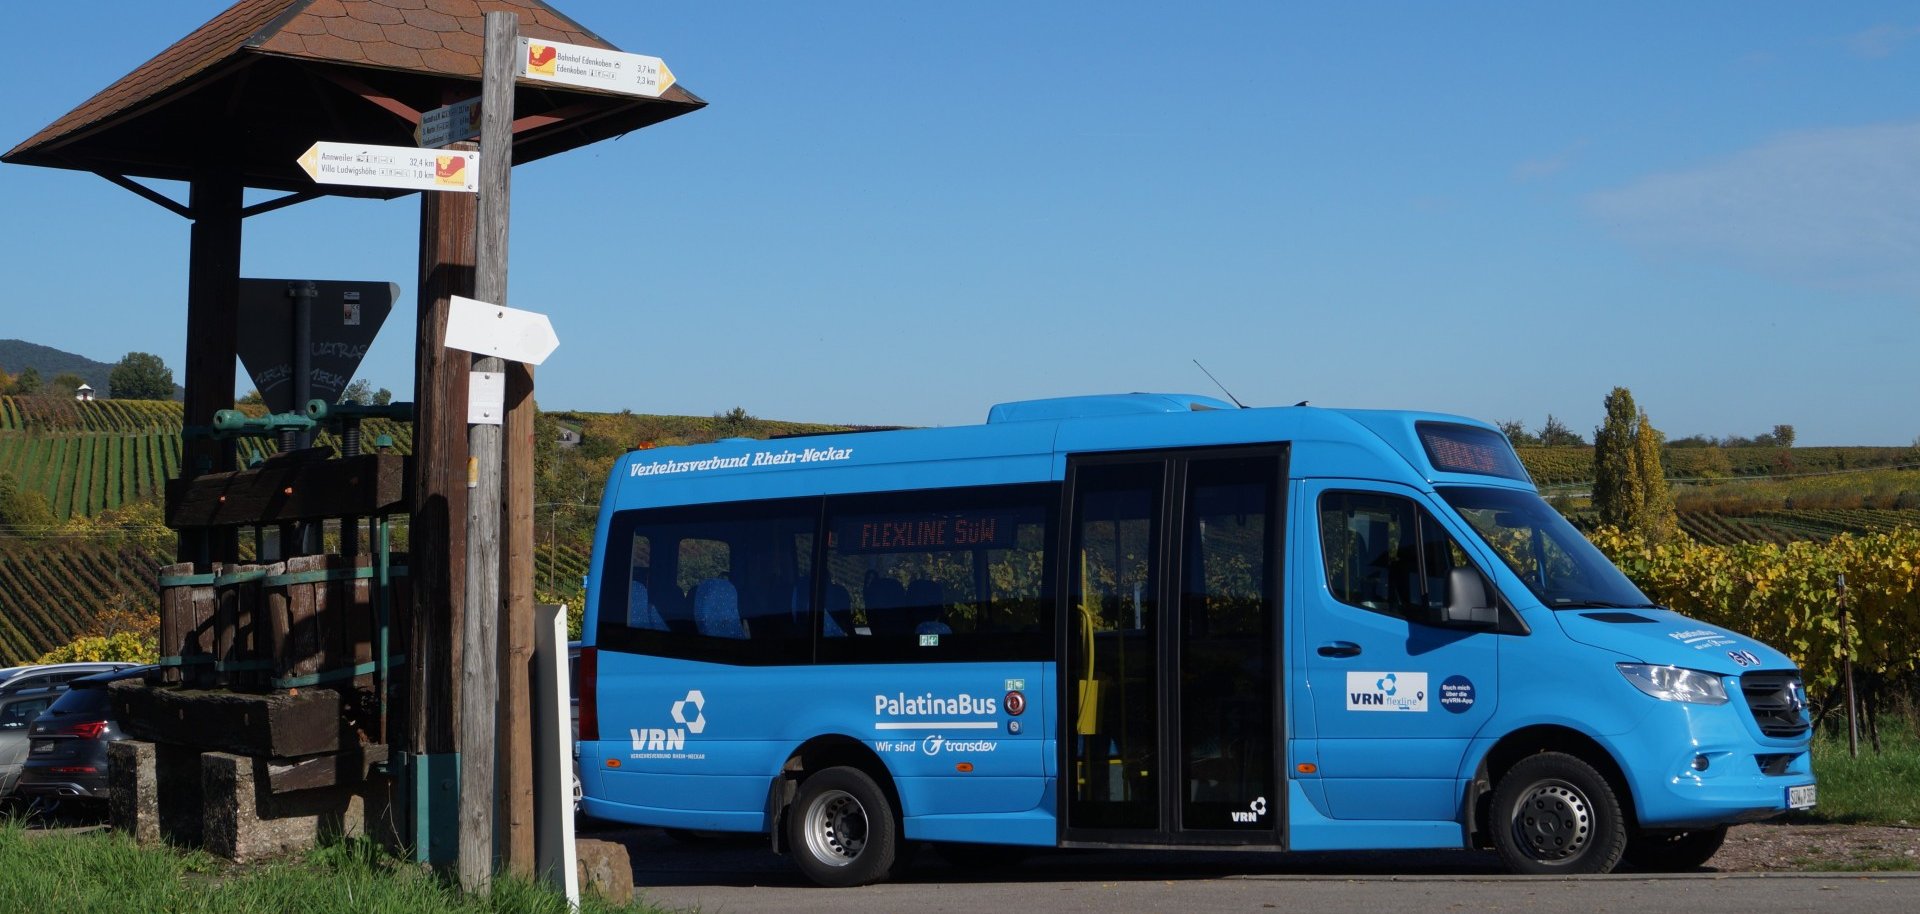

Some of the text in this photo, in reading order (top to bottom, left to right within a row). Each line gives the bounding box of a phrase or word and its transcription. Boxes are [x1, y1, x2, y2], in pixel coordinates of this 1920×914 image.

[557, 52, 581, 65] Bahnhof
[582, 56, 612, 69] Edenkoben
[637, 64, 647, 74] 3,7
[648, 66, 656, 75] km
[556, 64, 587, 76] Edenkoben
[636, 76, 646, 86] 2,3
[647, 77, 656, 86] km
[321, 152, 435, 168] Annweiler 32,4 km
[321, 164, 335, 174] Villa
[336, 166, 377, 177] Ludwigshöhe
[424, 170, 435, 180] km
[630, 448, 853, 477] Verkehrsverbund Rhein-Neckar
[861, 521, 947, 549] FLEXLINE
[875, 692, 997, 716] PalatinaBus
[1351, 693, 1417, 706] VRN flexline
[630, 729, 685, 750] VRN
[875, 740, 998, 752] Wir sind transdev
[1231, 812, 1257, 822] VRN
